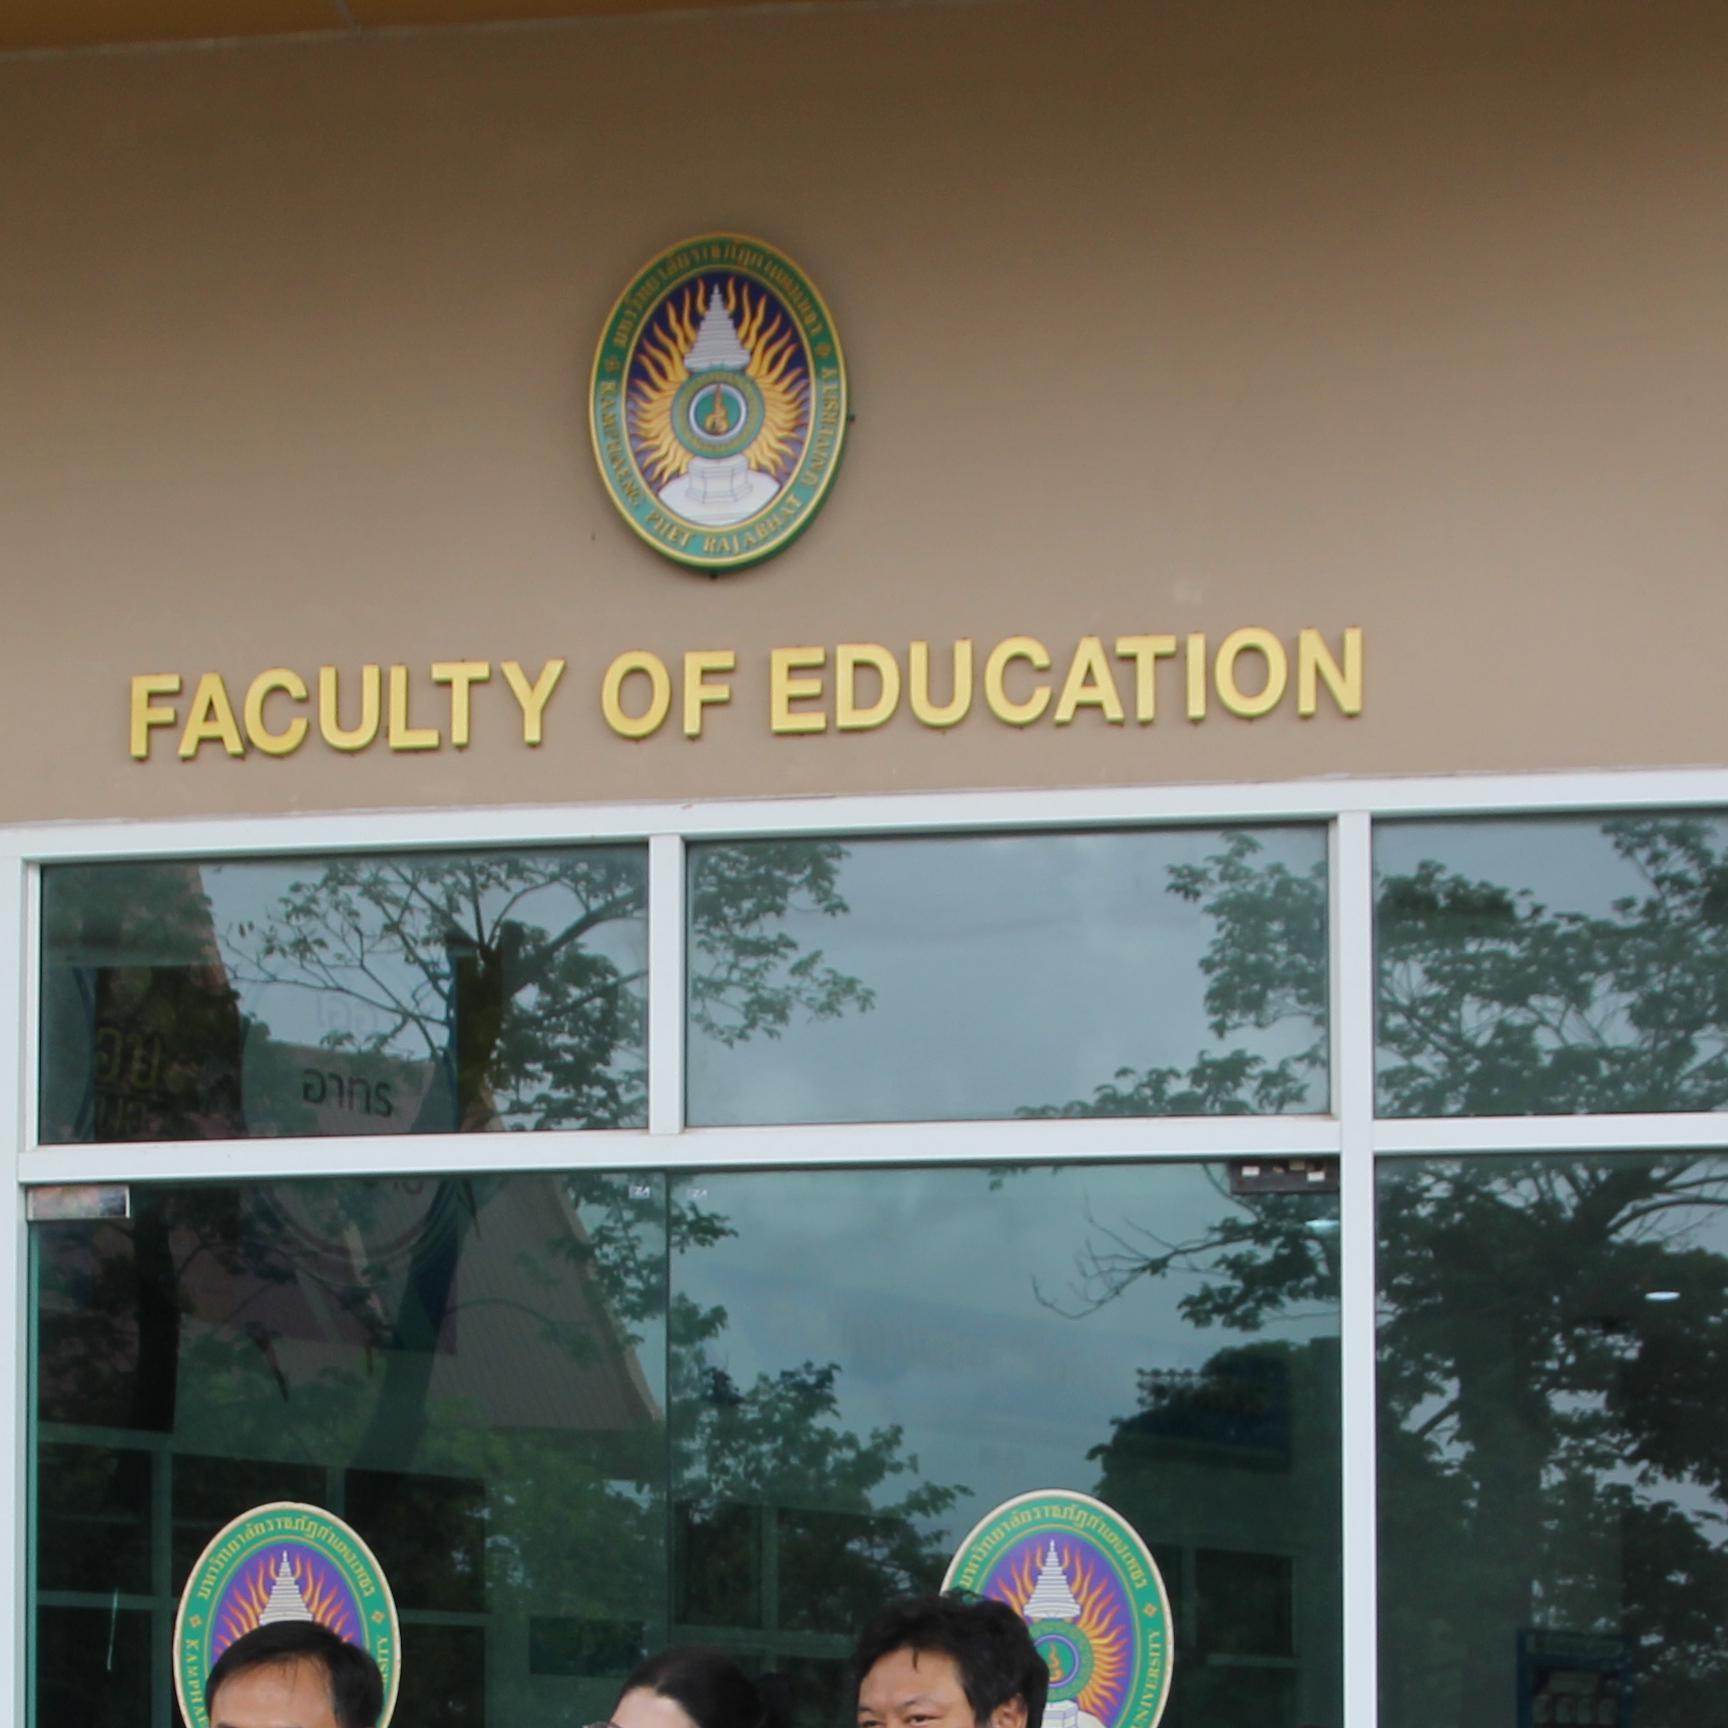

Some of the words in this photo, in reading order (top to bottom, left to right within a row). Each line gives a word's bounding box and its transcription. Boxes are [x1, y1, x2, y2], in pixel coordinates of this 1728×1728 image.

[646, 509, 695, 547] PHET
[703, 493, 805, 555] RAJABHAT
[803, 367, 839, 487] UNIVERSITY
[129, 659, 566, 760] FACULTY
[600, 649, 737, 738] OF
[769, 626, 1365, 735] EDUCATION
